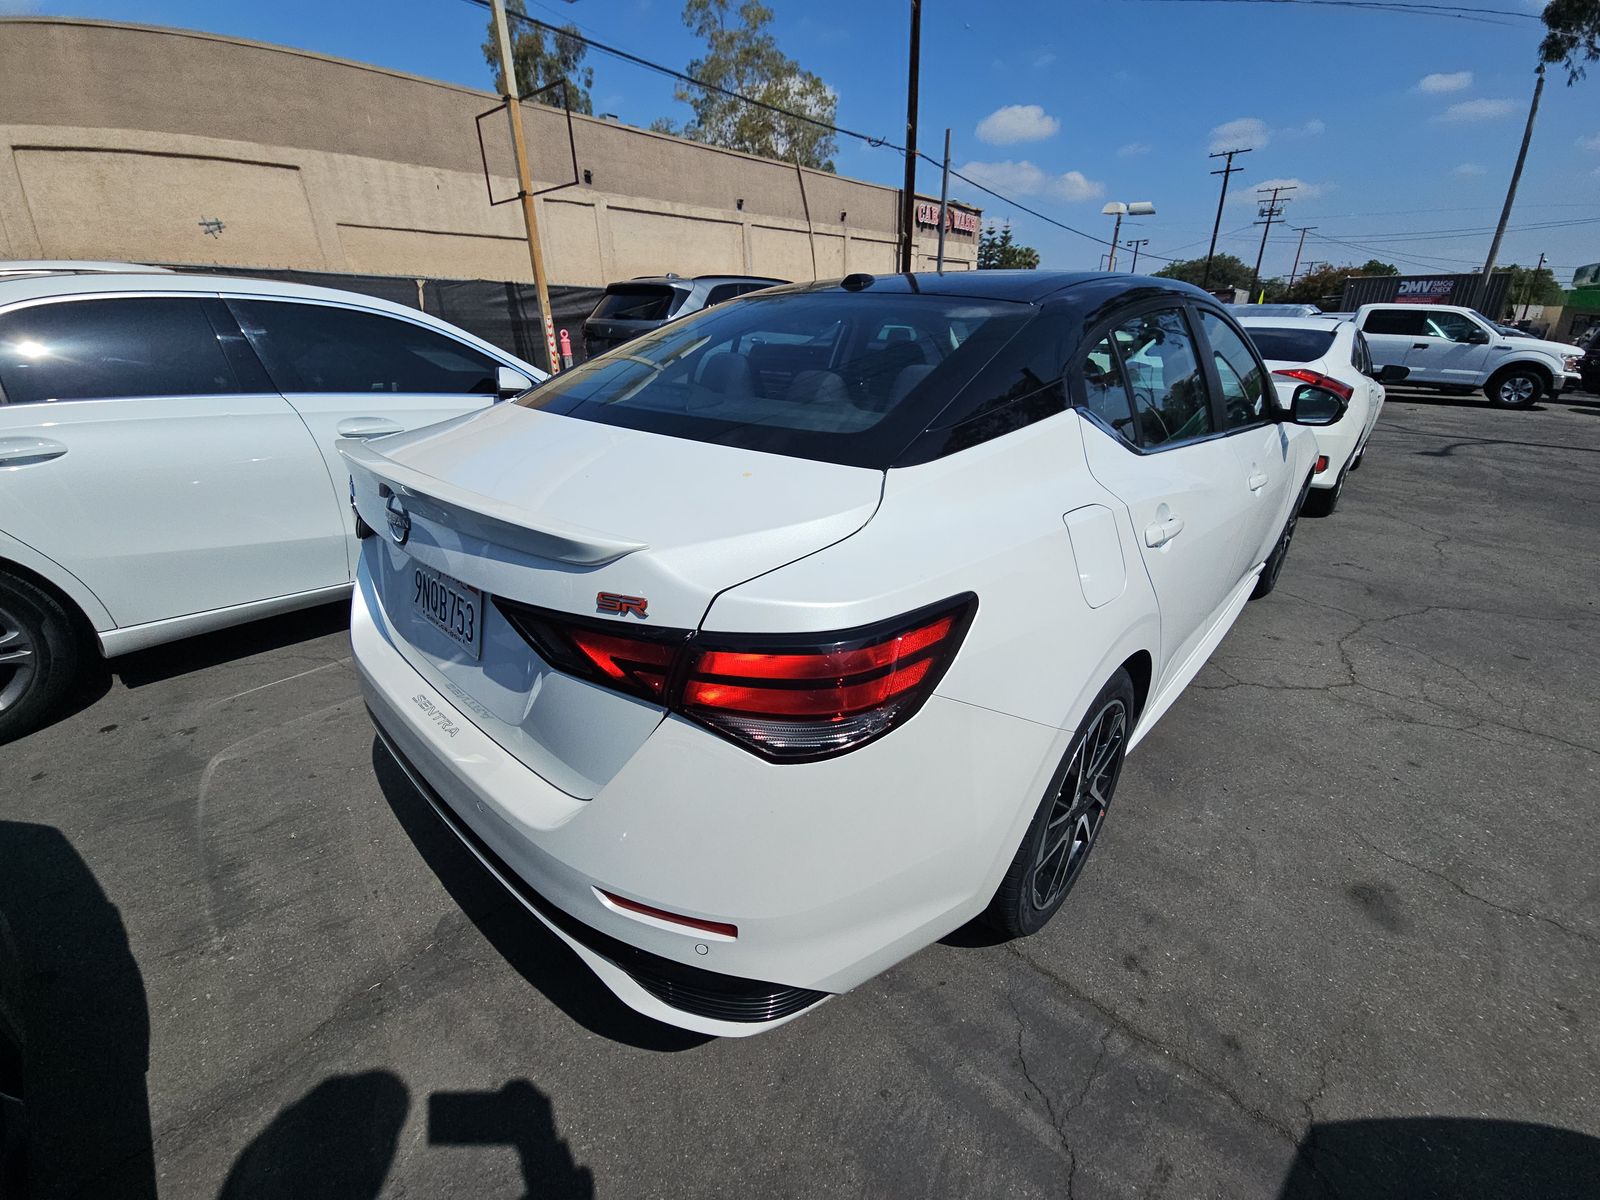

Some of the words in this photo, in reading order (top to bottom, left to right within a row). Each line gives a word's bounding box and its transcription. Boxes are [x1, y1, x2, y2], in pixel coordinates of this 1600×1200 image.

[918, 203, 939, 226] CAR
[1399, 281, 1433, 293] DMV
[415, 569, 475, 642] 9NQB753
[596, 591, 649, 618] SR
[412, 694, 460, 738] SENTRA
